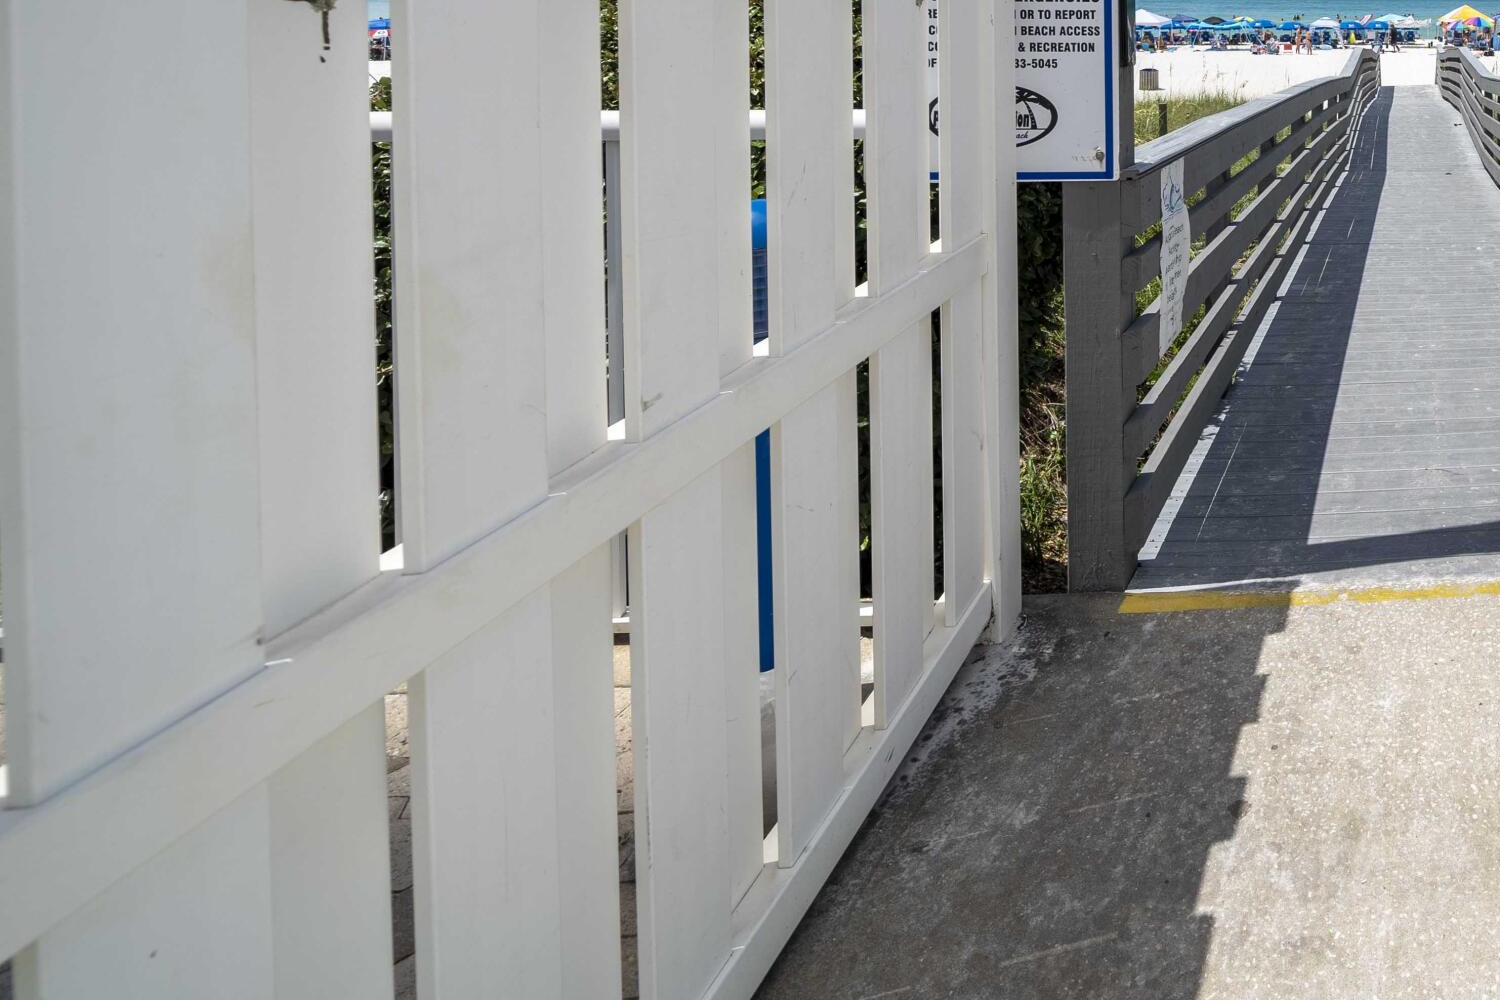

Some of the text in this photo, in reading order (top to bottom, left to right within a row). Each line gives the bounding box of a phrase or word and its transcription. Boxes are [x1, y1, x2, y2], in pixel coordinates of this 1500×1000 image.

[1020, 9, 1096, 19] OR TO REPORT
[1021, 26, 1100, 36] BEACH ACCESS
[1018, 42, 1095, 52] & RECREATION
